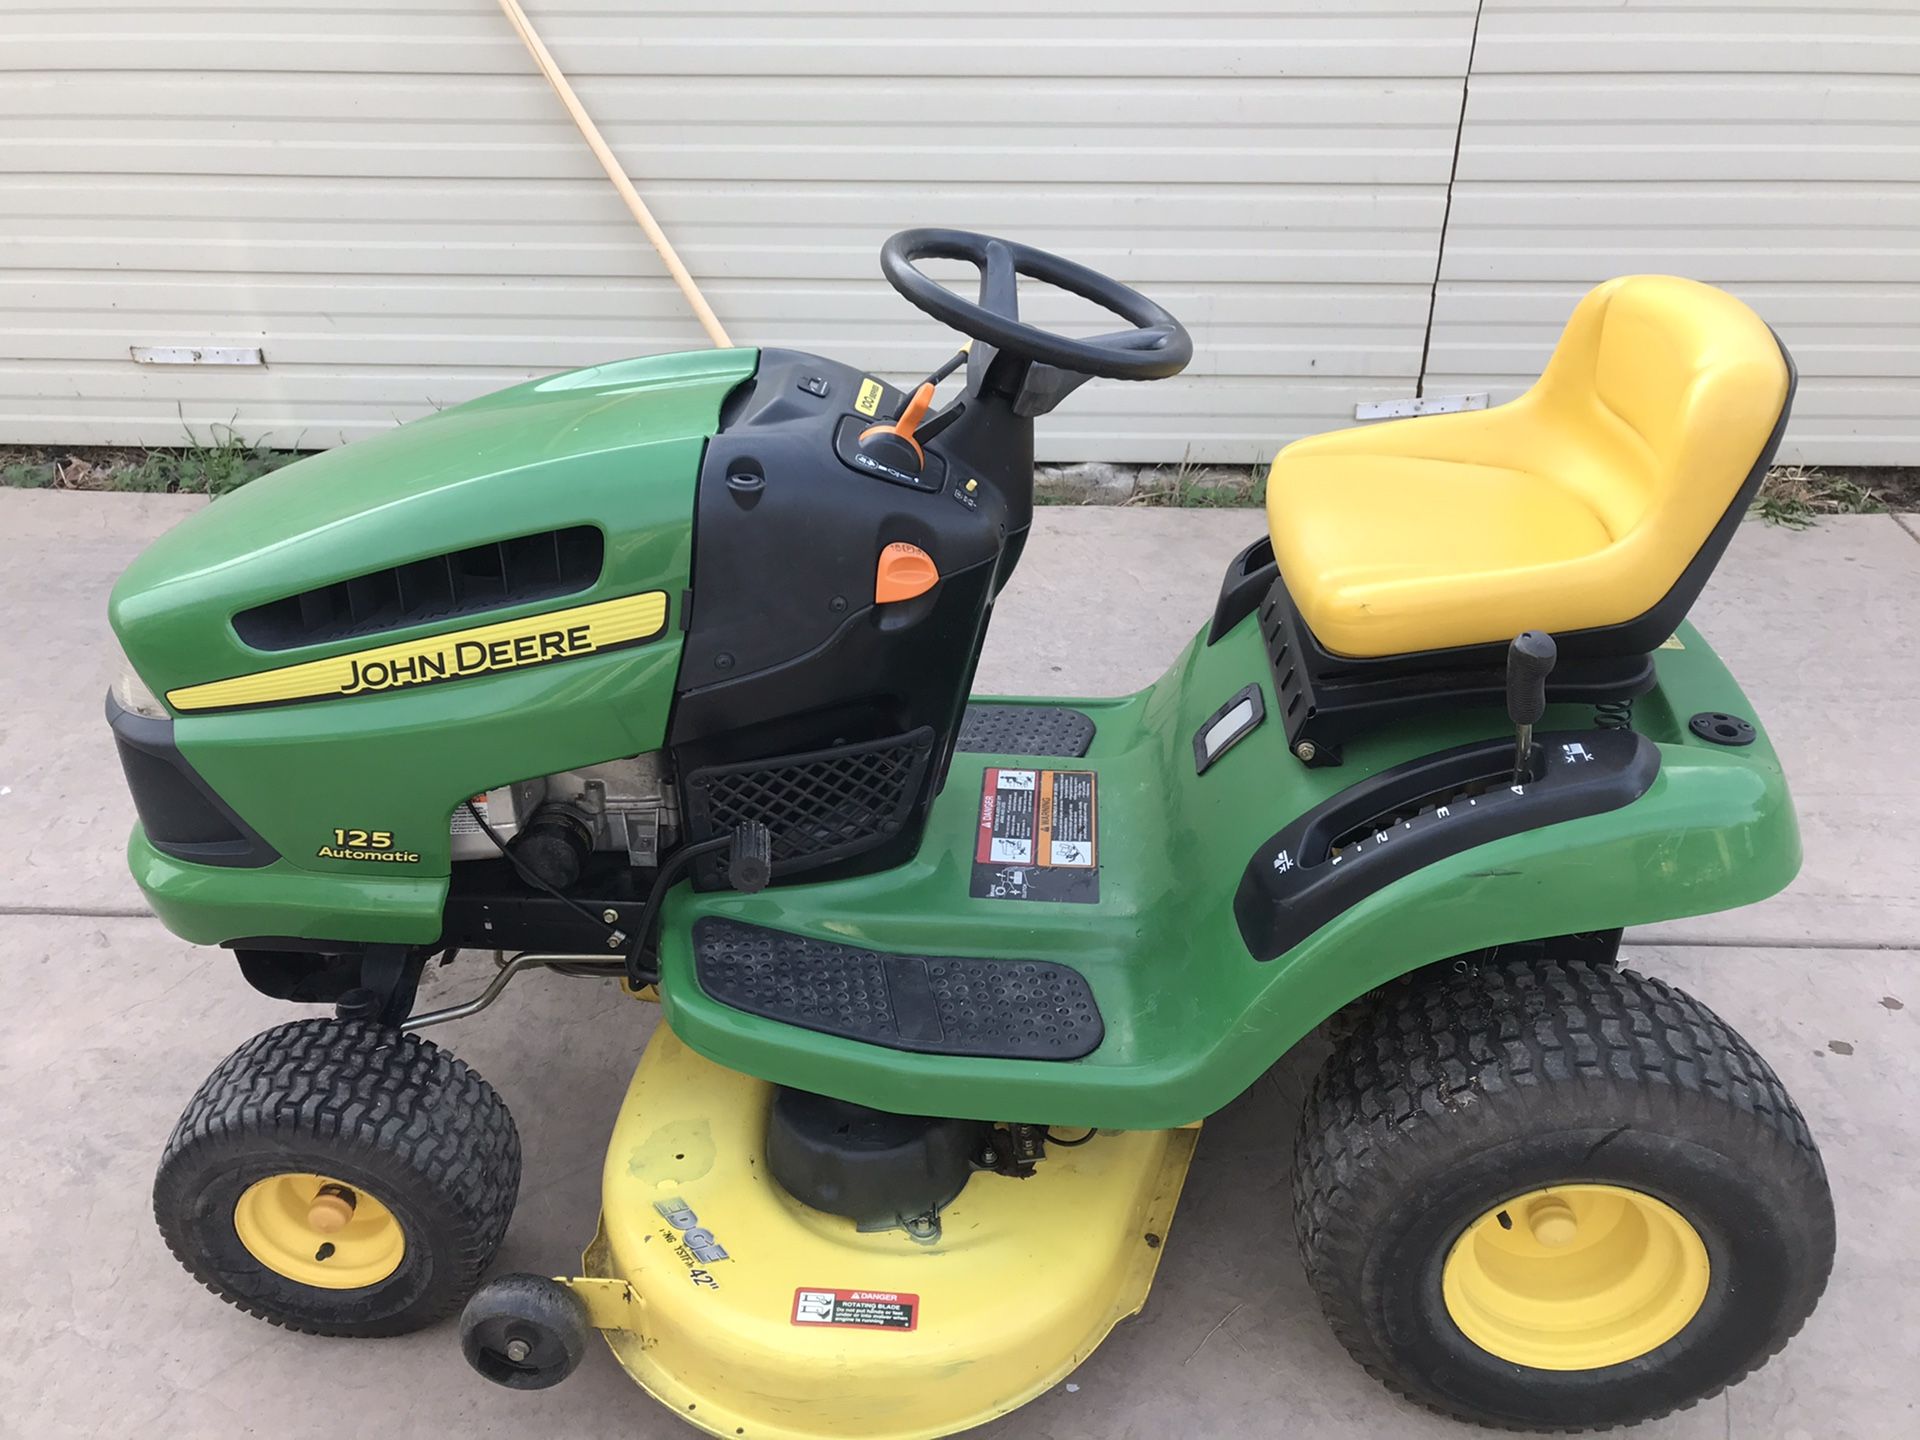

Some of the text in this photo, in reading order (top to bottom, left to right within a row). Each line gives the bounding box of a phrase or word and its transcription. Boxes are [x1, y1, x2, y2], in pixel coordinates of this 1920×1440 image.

[861, 396, 874, 411] 100
[340, 624, 592, 691] JOHN DEERE
[982, 795, 994, 820] DANGER
[1041, 797, 1050, 828] WARNING
[1376, 830, 1389, 844] 2
[1436, 806, 1450, 819] 3
[1510, 785, 1524, 795] 4
[335, 829, 391, 848] 125
[318, 846, 419, 862] Automatic
[653, 1196, 729, 1264] EDGE
[860, 1292, 897, 1301] DANGER
